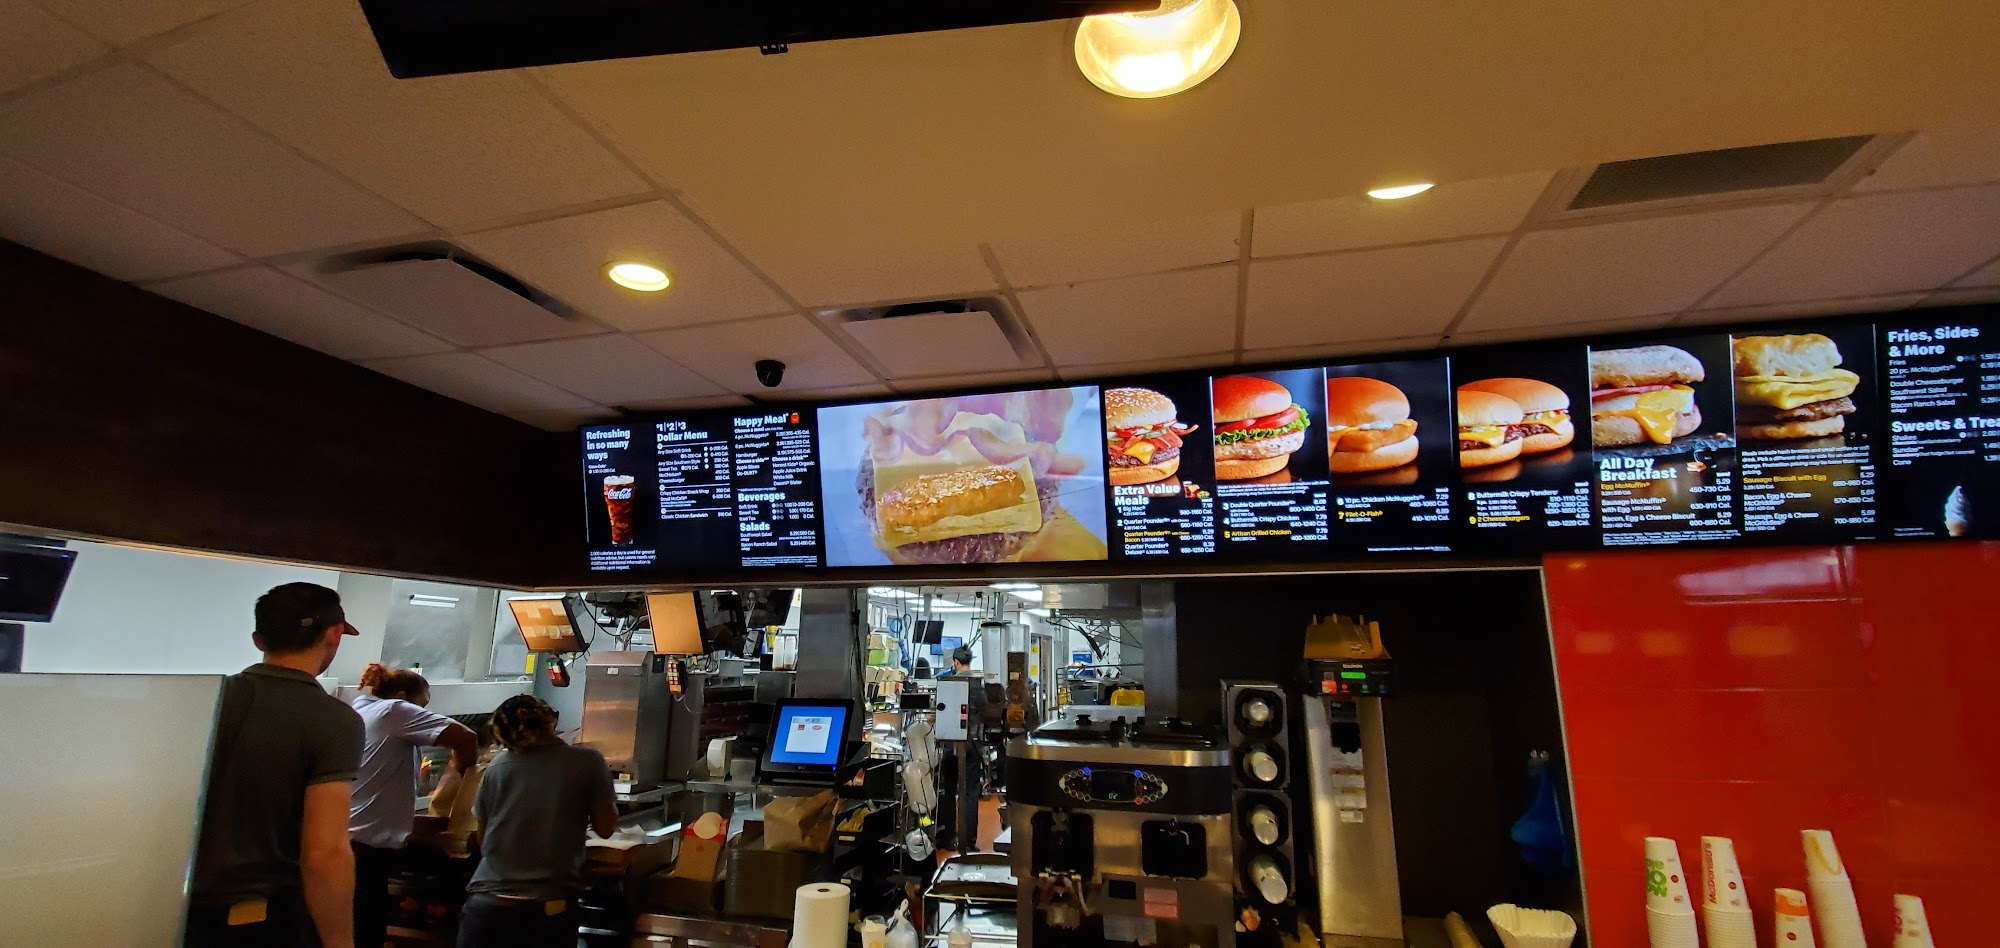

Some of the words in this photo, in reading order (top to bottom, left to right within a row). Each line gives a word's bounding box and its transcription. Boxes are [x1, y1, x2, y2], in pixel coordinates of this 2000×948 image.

[1888, 329, 1932, 342] Fries,
[1934, 326, 1980, 339] Sides
[1889, 345, 1902, 357] &
[1904, 344, 1946, 356] More
[734, 418, 763, 428] Happy
[1891, 419, 1951, 433] Sweets
[1953, 417, 1967, 430] &
[586, 428, 631, 440] Refreshing
[656, 433, 683, 442] Dollar
[684, 431, 708, 440] Menu
[586, 440, 595, 450] in
[595, 442, 606, 450] so
[606, 440, 630, 450] many
[586, 452, 608, 461] ways
[1600, 458, 1622, 470] All
[1624, 456, 1655, 471] Day
[1600, 467, 1677, 482] Breakfast
[1743, 476, 1773, 484] Sausage
[1813, 474, 1827, 482] Egg
[1114, 486, 1145, 496] Extra
[1146, 484, 1181, 494] Value
[1600, 483, 1614, 491] Egg
[738, 493, 786, 503] Beverages
[1115, 495, 1150, 506] Meals
[1468, 492, 1476, 501] 8
[1477, 491, 1509, 499] Buttermilk
[1509, 490, 1530, 498] Crispy
[1743, 493, 1766, 501] Bacon,
[1766, 493, 1780, 501] Egg
[1786, 491, 1812, 499] Cheese
[1222, 502, 1230, 510] 3
[1249, 501, 1268, 509] Quarter
[1336, 497, 1345, 506] 6
[1718, 502, 1732, 510] Cal.
[1117, 506, 1122, 514] 1
[1616, 506, 1631, 514] Egg
[1223, 517, 1230, 525] 4
[1277, 514, 1300, 522] Chicken
[1338, 511, 1345, 520] 7
[1469, 516, 1477, 525] 9
[1482, 515, 1530, 523] Cheeseburgers
[1602, 515, 1625, 523] Bacon,
[1625, 514, 1639, 522] Egg
[1646, 513, 1672, 521] Cheese
[1672, 512, 1696, 520] Biscuit
[1774, 513, 1788, 521] Egg
[1793, 511, 1820, 519] Cheese
[740, 522, 771, 532] Salads
[1117, 519, 1123, 527] 2
[1123, 518, 1143, 526] Quarter
[1718, 518, 1732, 526] Cal.
[1124, 531, 1143, 539] Quarter
[1224, 531, 1231, 539] 5
[1269, 528, 1292, 536] Chicken
